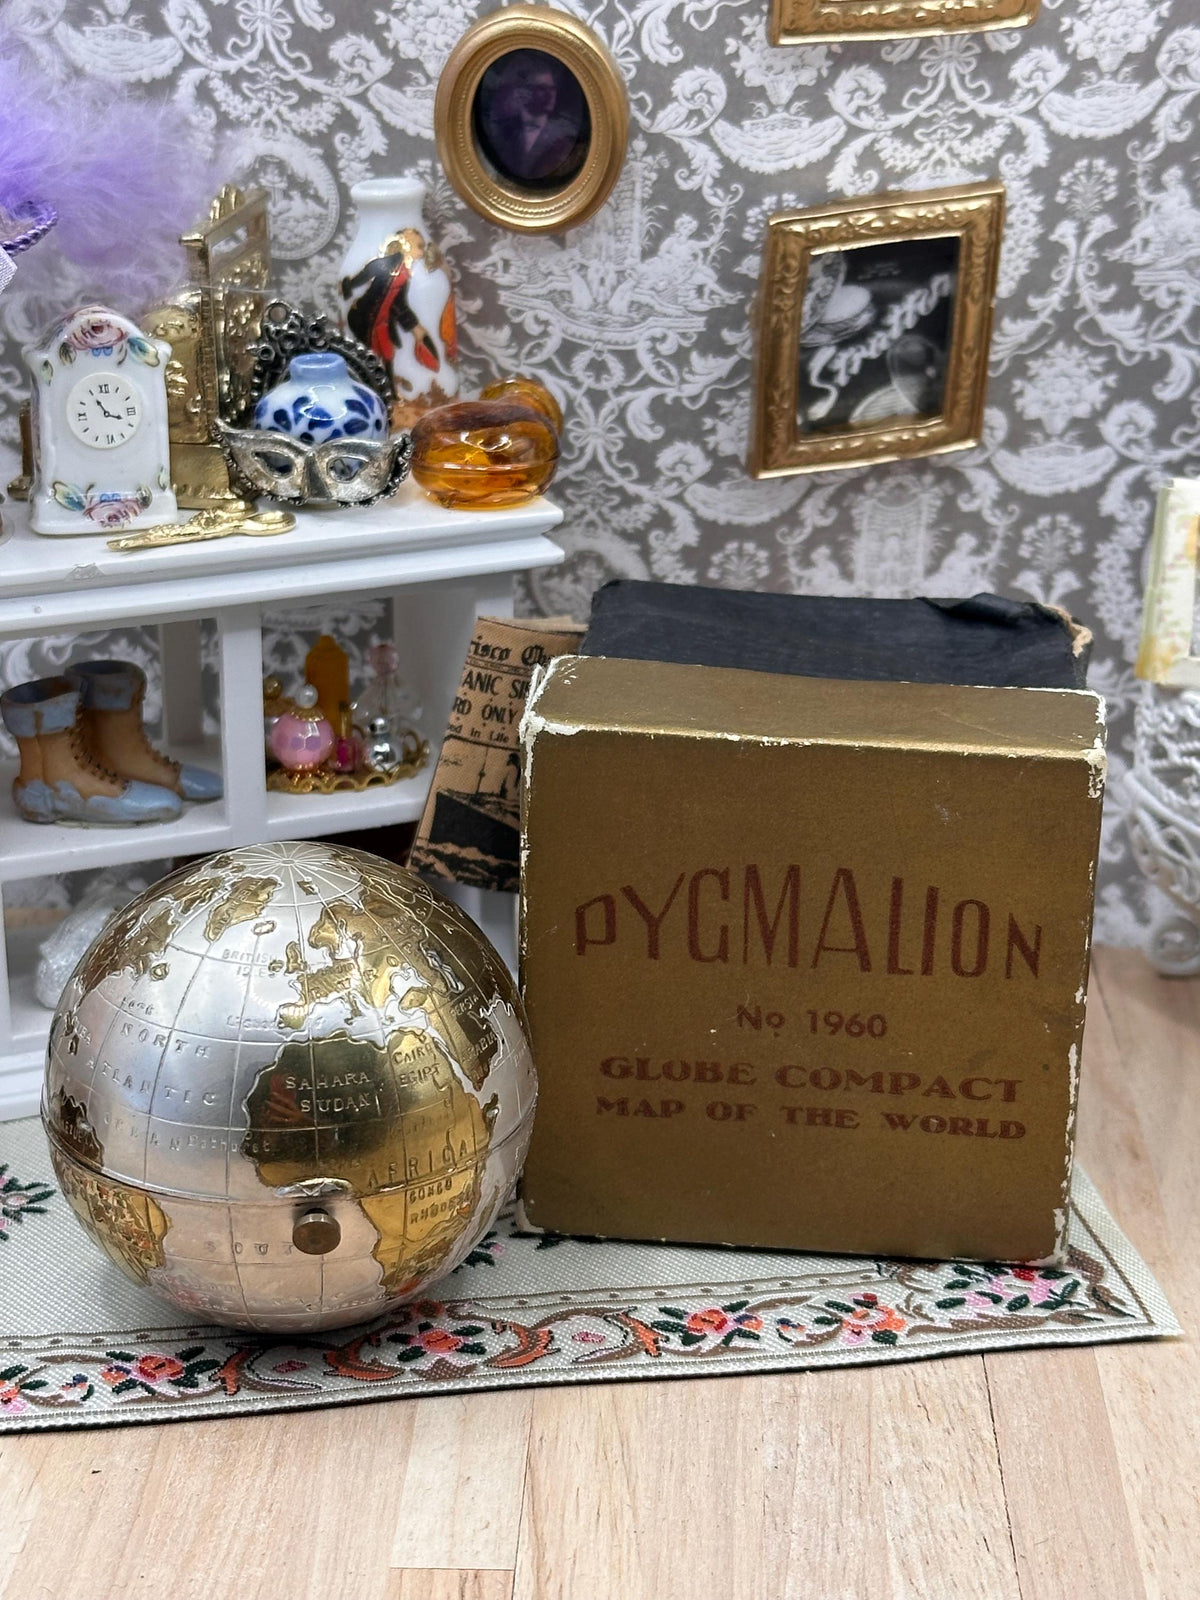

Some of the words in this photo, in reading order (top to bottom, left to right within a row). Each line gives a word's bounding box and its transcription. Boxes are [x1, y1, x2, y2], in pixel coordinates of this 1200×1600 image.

[98, 384, 110, 394] XII
[482, 703, 519, 725] ONLY
[575, 864, 1042, 980] PYGMALION
[120, 1021, 210, 1058] NORTH
[806, 1008, 889, 1039] 1960
[394, 1042, 435, 1064] CAIRO
[86, 1059, 217, 1106] ATLANTIC
[285, 1071, 371, 1090] SAHARA
[600, 1056, 757, 1086] GLOBE
[775, 1064, 1023, 1103] COMPACT
[300, 1092, 371, 1113] SUDAN
[596, 1095, 684, 1119] MAP
[706, 1101, 758, 1122] OF
[780, 1107, 860, 1130] THE
[880, 1112, 1027, 1140] WORLD
[367, 1140, 468, 1188] AFRICA
